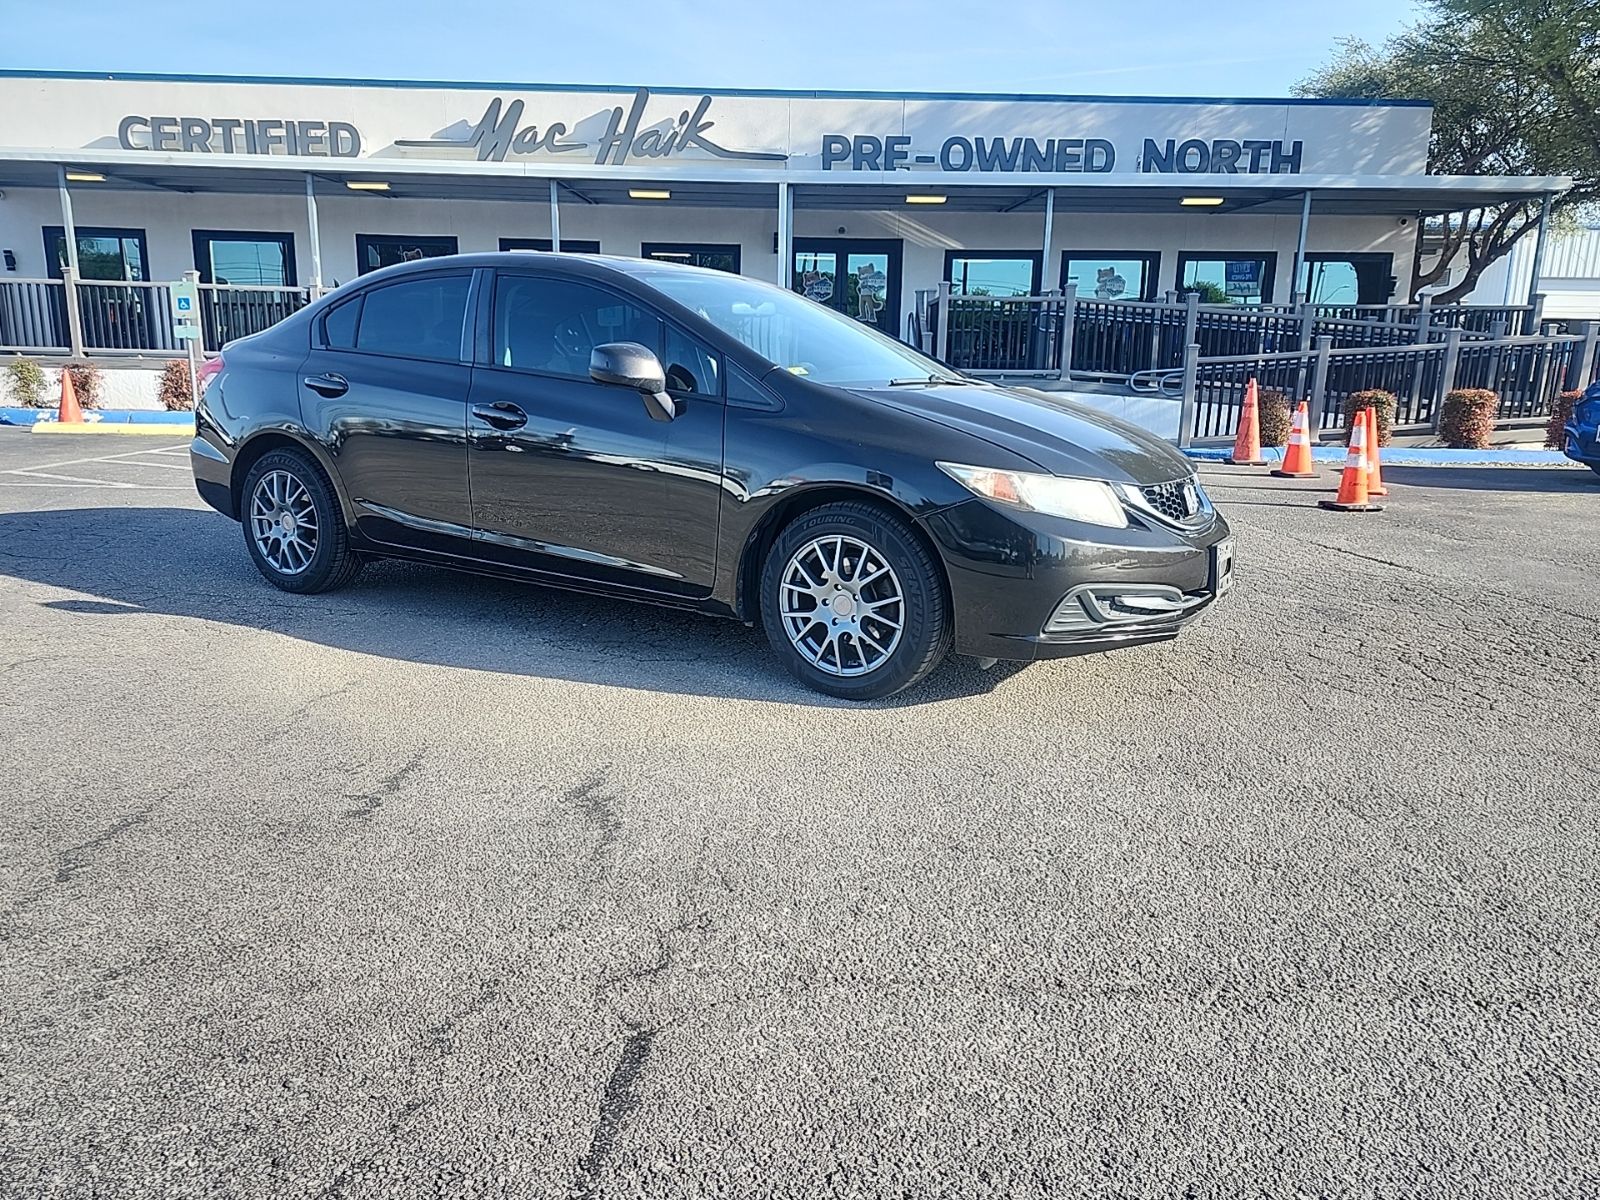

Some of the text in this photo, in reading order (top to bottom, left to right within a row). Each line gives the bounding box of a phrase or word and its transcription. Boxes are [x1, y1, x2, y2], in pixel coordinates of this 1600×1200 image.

[118, 115, 361, 158] CERTIFIED
[394, 87, 789, 166] Mac Haik
[821, 134, 1303, 174] PRE-OWNED NORTH
[802, 515, 856, 530] TOURING
